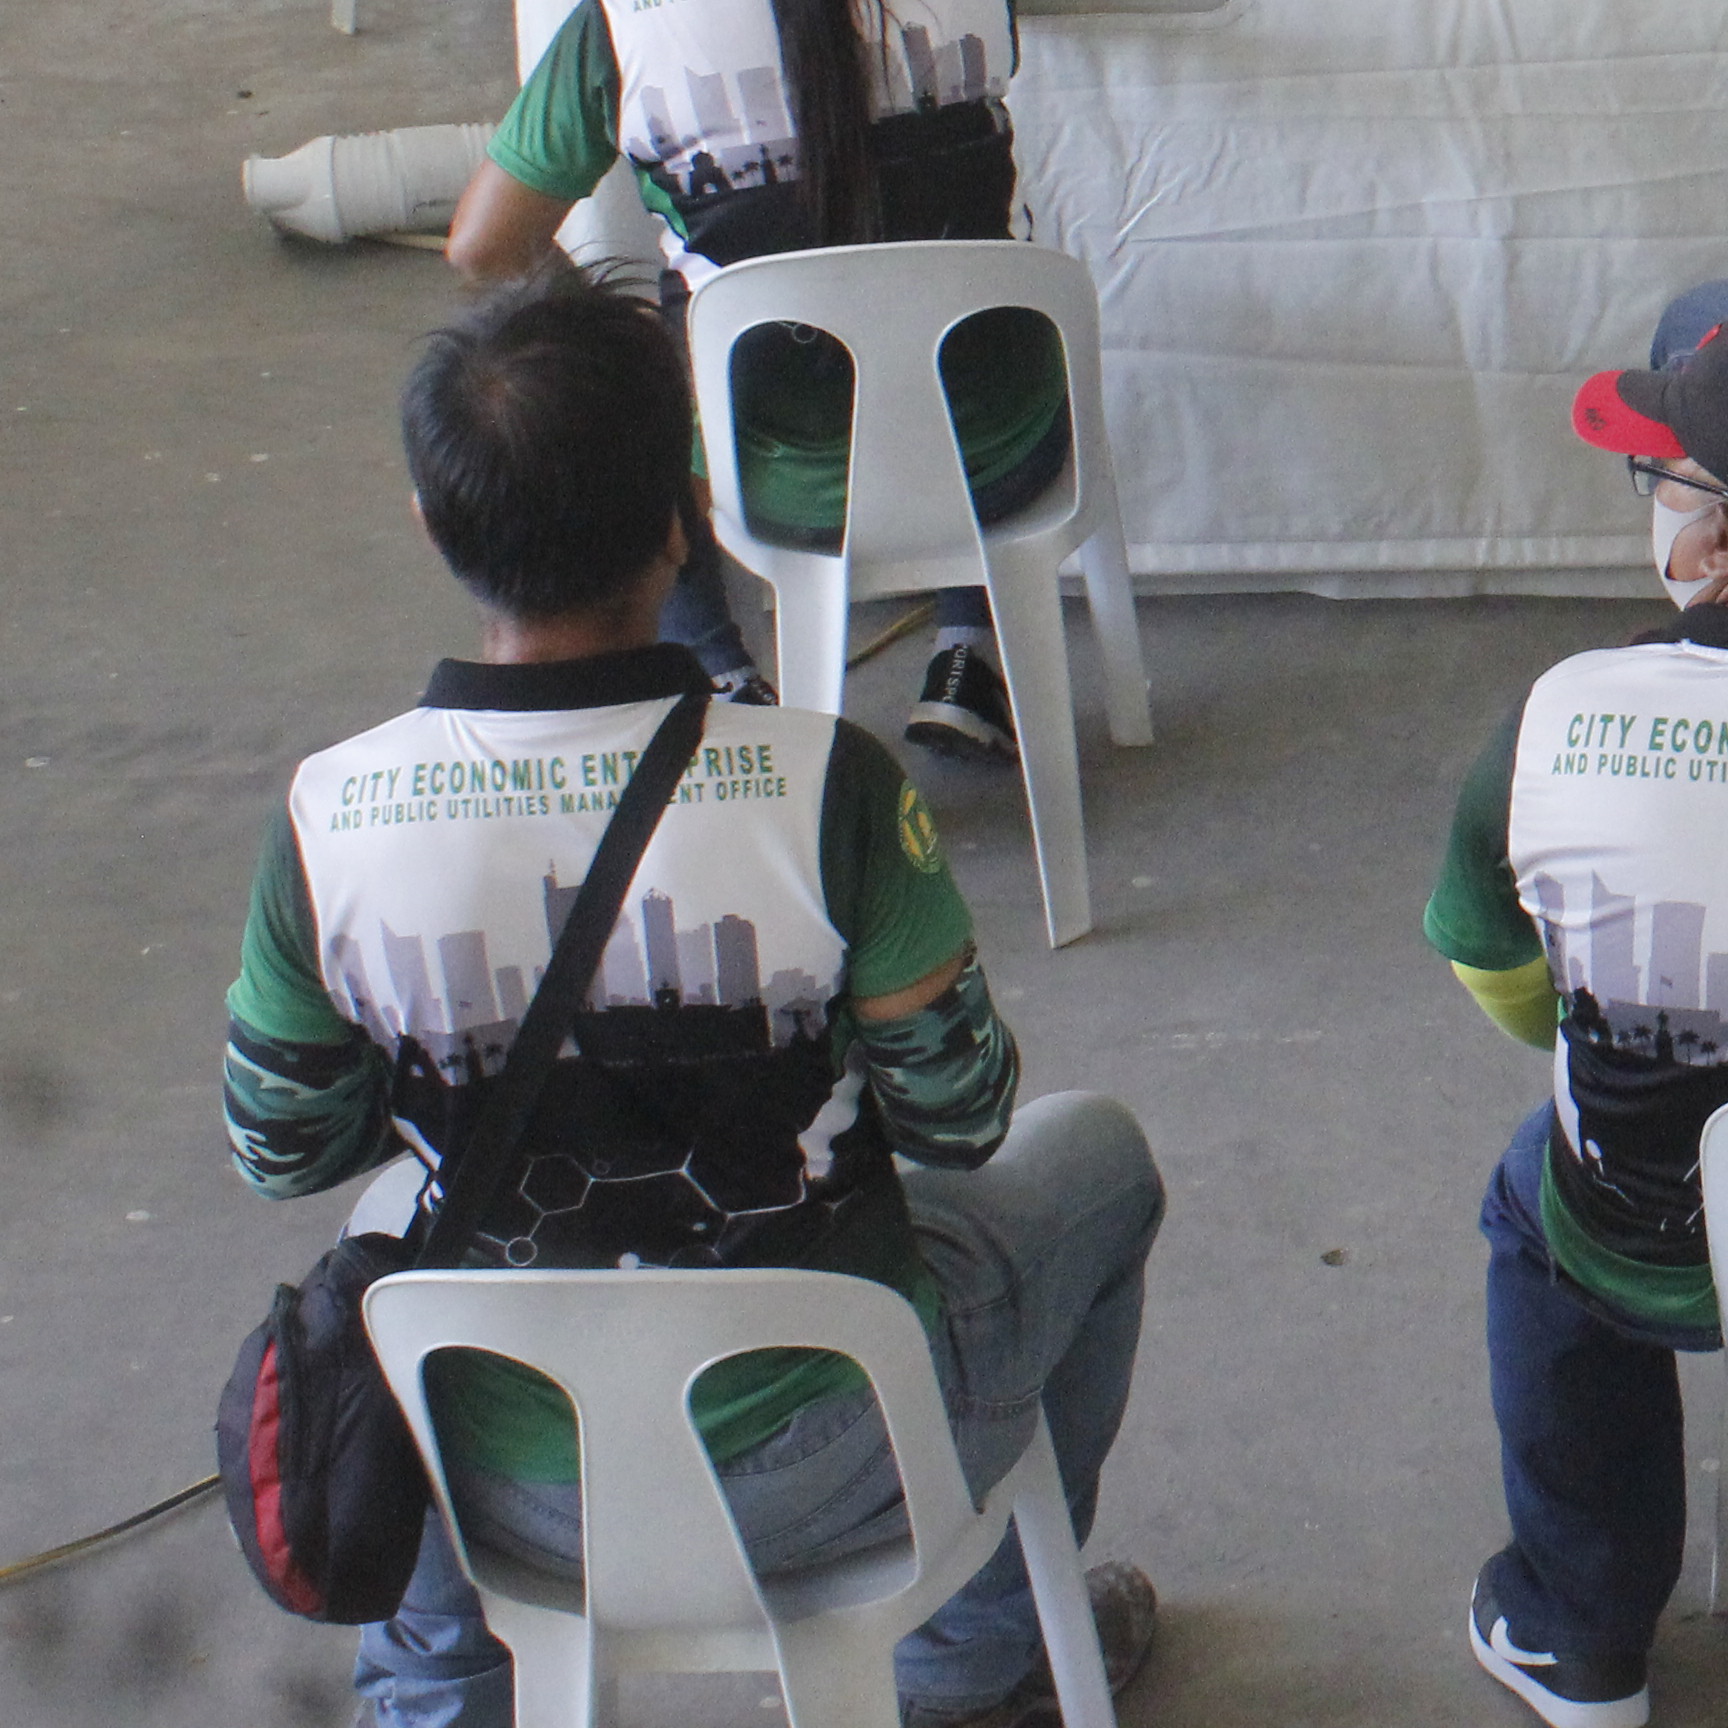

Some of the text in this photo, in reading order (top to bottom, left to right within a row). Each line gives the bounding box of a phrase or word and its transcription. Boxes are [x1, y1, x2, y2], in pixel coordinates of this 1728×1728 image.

[1567, 713, 1636, 749] CITY
[342, 744, 773, 806] CITY ECONOMIC ENTPRISE
[1552, 753, 1588, 775] AND
[1597, 754, 1676, 779] PUBLIC
[331, 777, 787, 832] AND PUBLIC UTILITIES MANANT OFFICE
